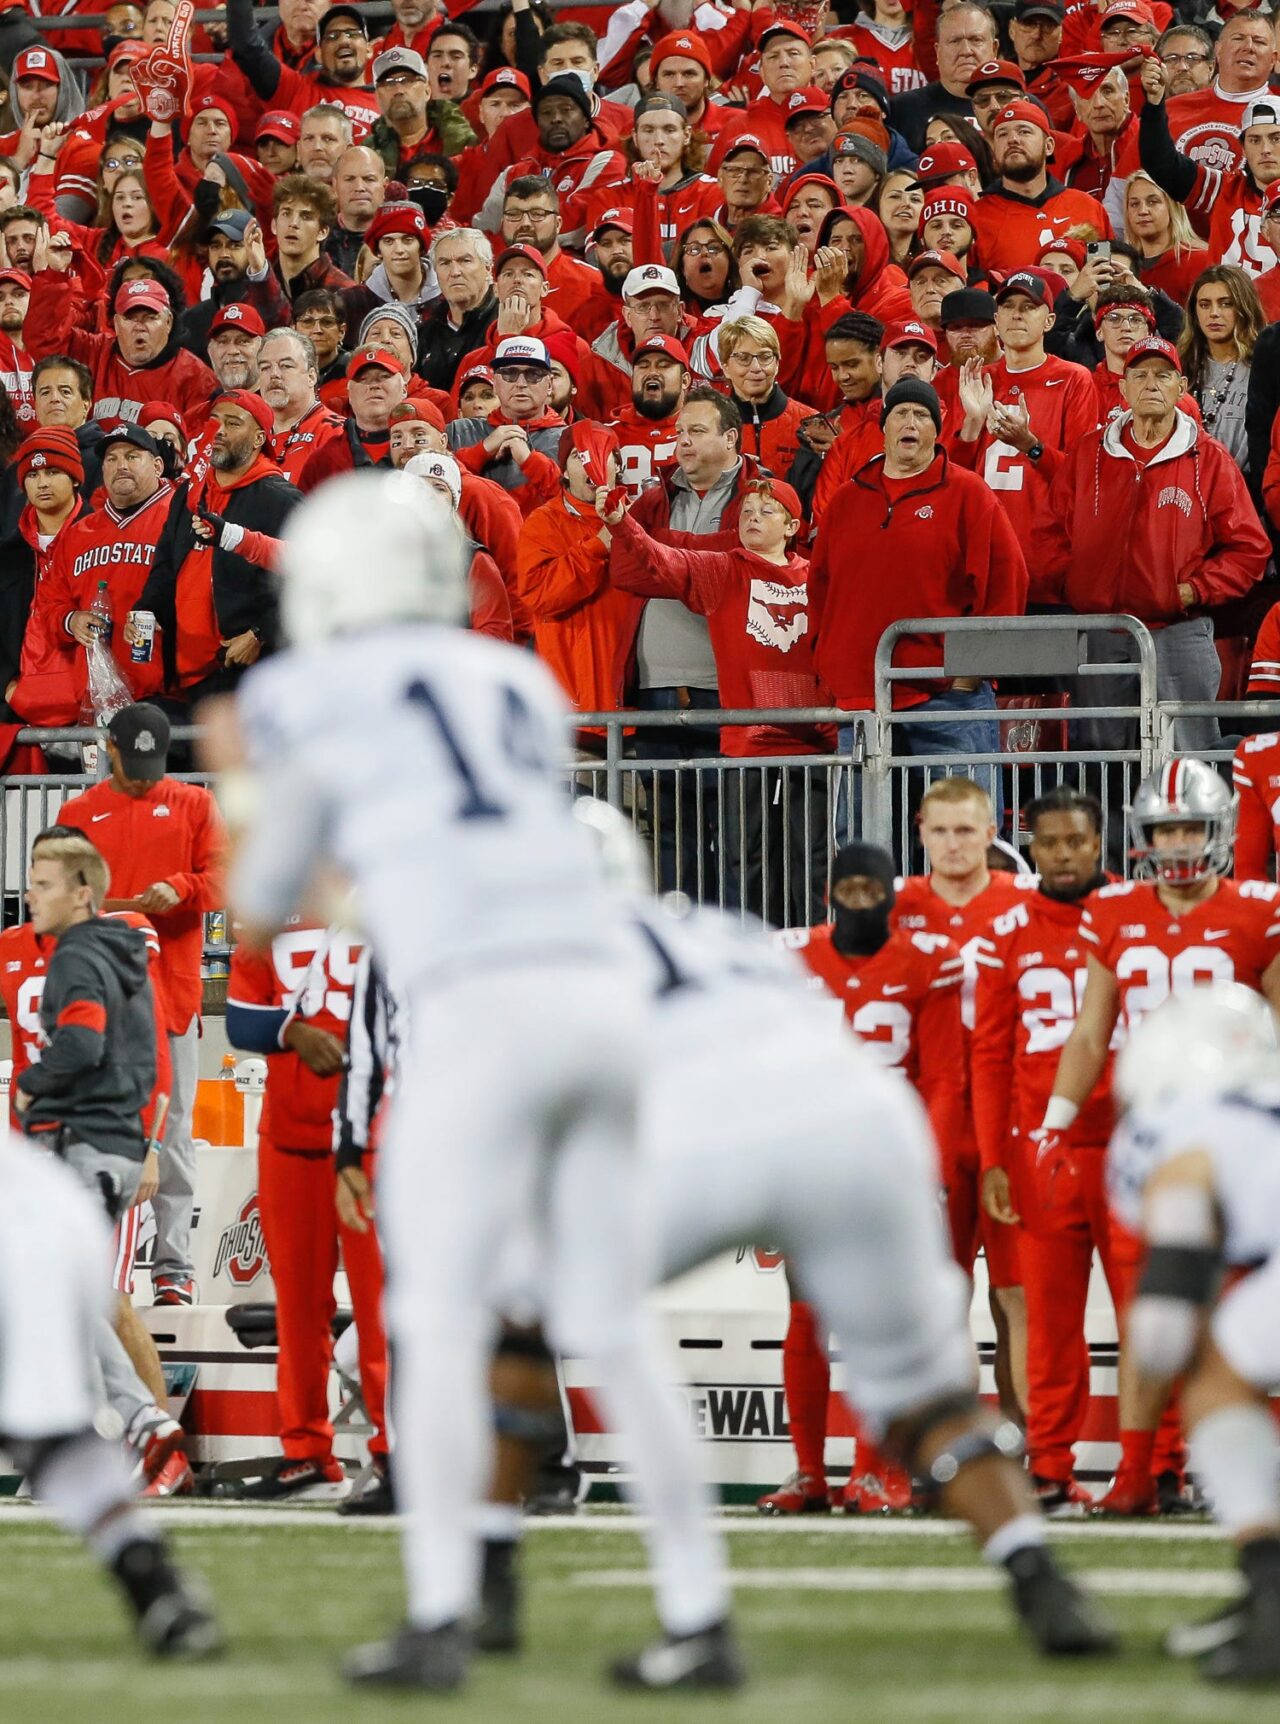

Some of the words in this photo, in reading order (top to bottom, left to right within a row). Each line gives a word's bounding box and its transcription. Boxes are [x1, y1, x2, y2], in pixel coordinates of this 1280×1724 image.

[924, 200, 968, 219] OHIO
[1222, 207, 1278, 279] 15
[73, 543, 155, 577] OHIOSTAT
[692, 1389, 793, 1436] EWAL
